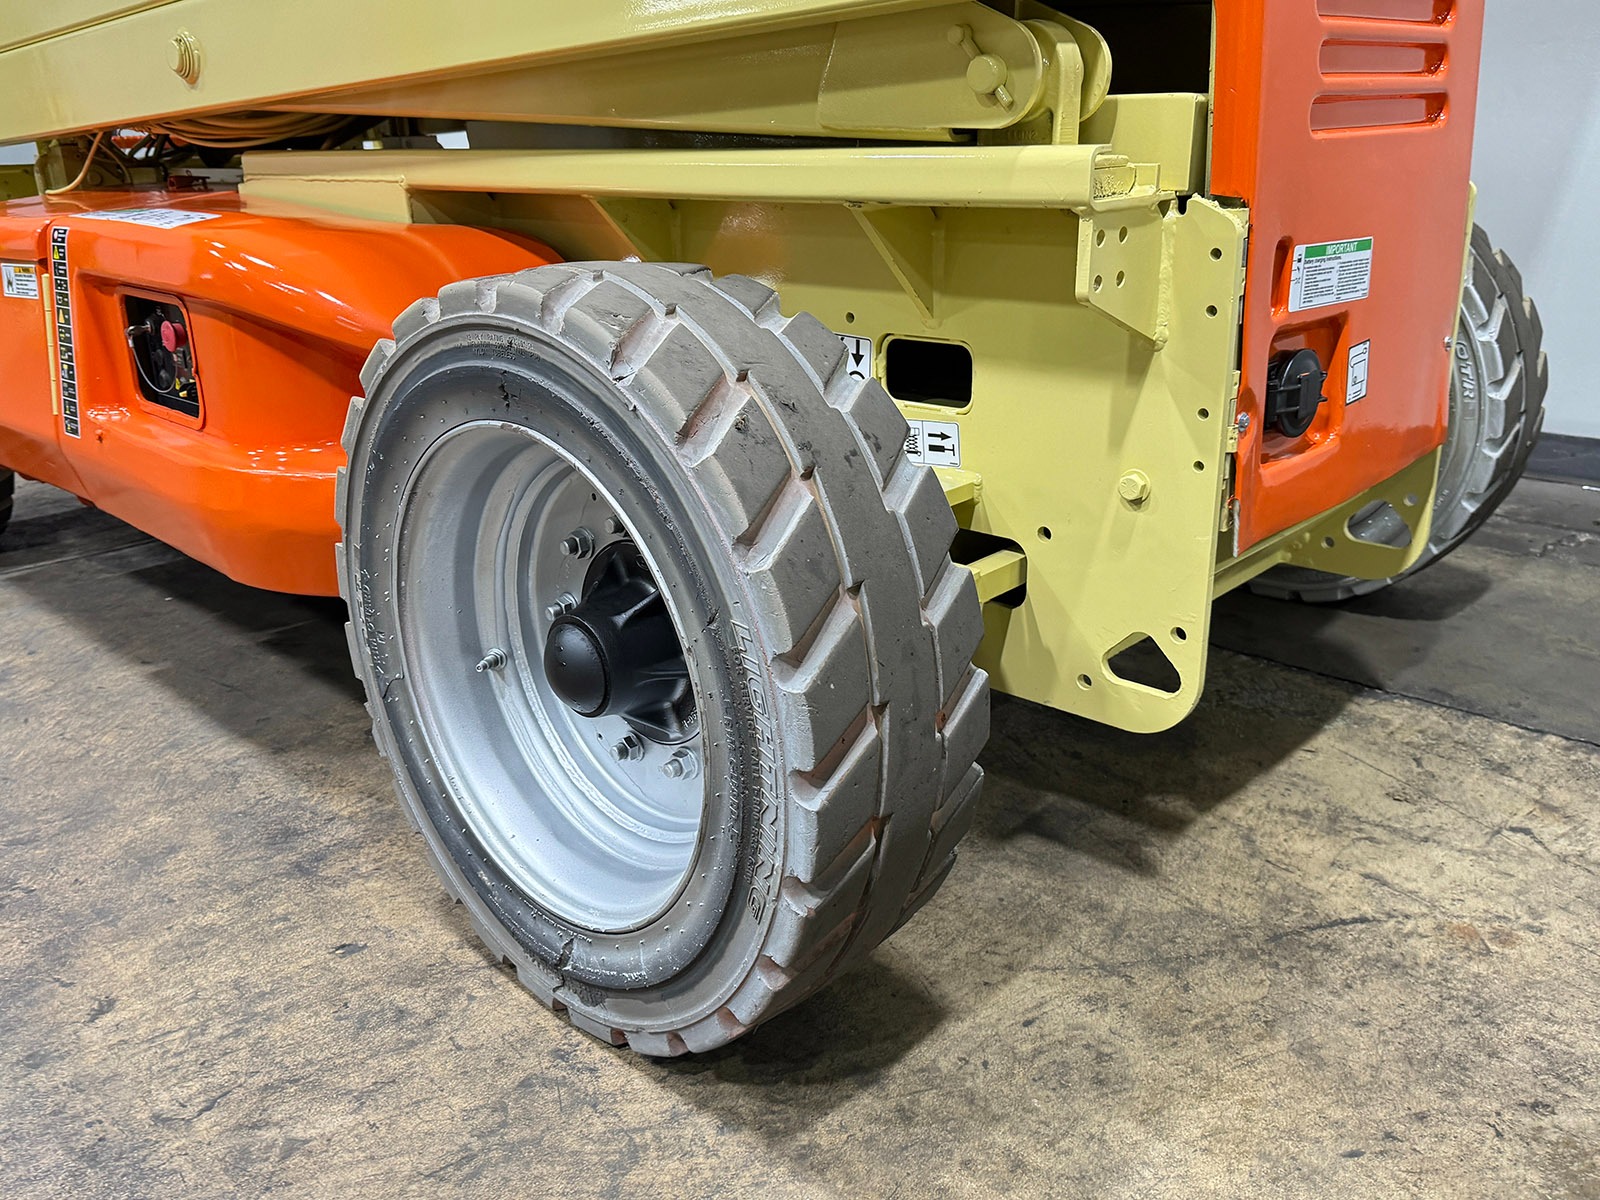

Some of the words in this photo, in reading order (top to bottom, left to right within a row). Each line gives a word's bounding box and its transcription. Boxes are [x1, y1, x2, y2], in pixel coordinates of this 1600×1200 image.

[1326, 242, 1358, 255] IMPORTANT
[1455, 341, 1475, 399] OTR
[730, 645, 745, 676] FOR
[739, 680, 757, 738] SERVICE
[750, 746, 760, 777] CALL
[730, 619, 778, 926] LIGHTNING
